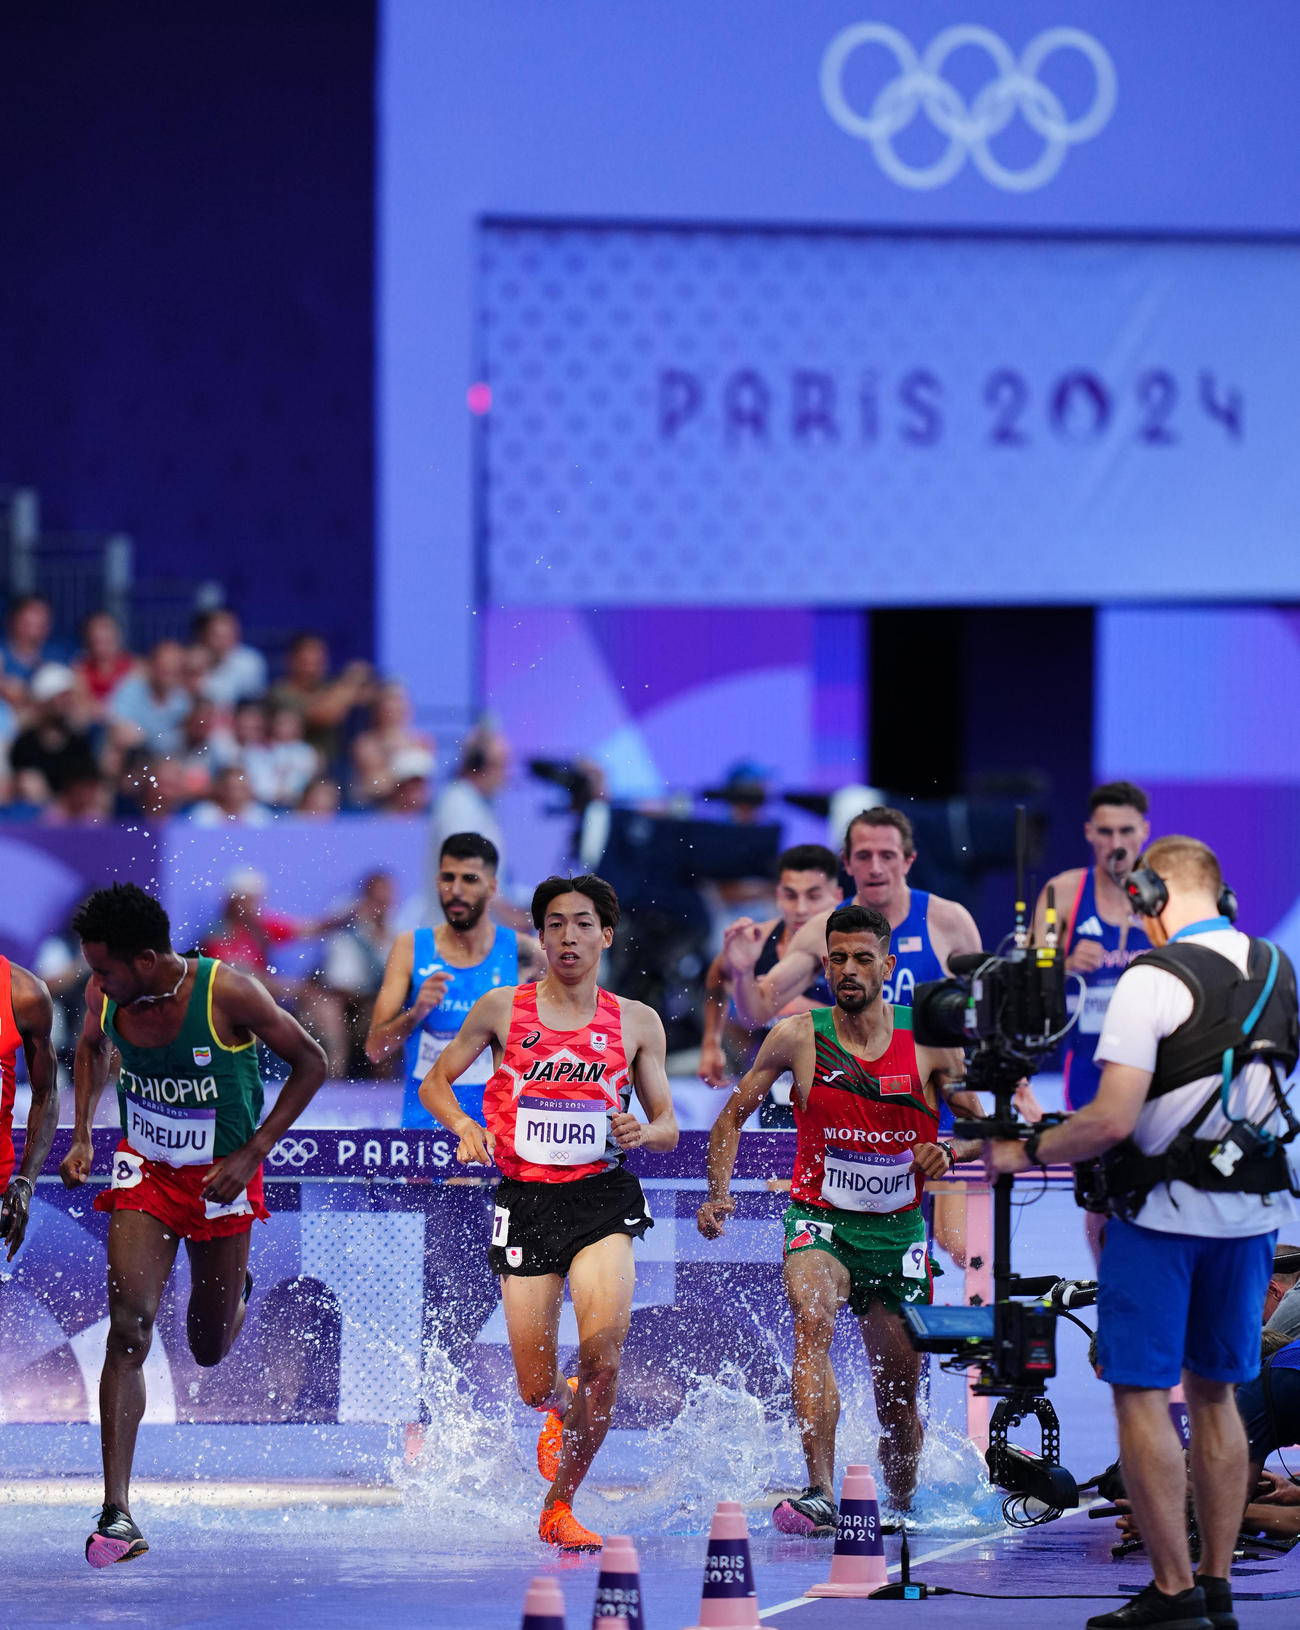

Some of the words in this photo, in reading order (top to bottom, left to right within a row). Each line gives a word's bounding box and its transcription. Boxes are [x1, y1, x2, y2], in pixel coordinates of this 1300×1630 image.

[982, 367, 1245, 447] 2024
[522, 1060, 607, 1083] JAPAN
[565, 1102, 586, 1110] 2024
[132, 1111, 206, 1151] FIREWU
[526, 1120, 596, 1146] MIURA
[823, 1127, 917, 1143] MOROCCO
[116, 1160, 134, 1181] 8
[874, 1156, 896, 1164] 2024
[826, 1167, 912, 1194] TINDOUFT
[911, 1248, 924, 1271] 9
[836, 1528, 876, 1542] 2024
